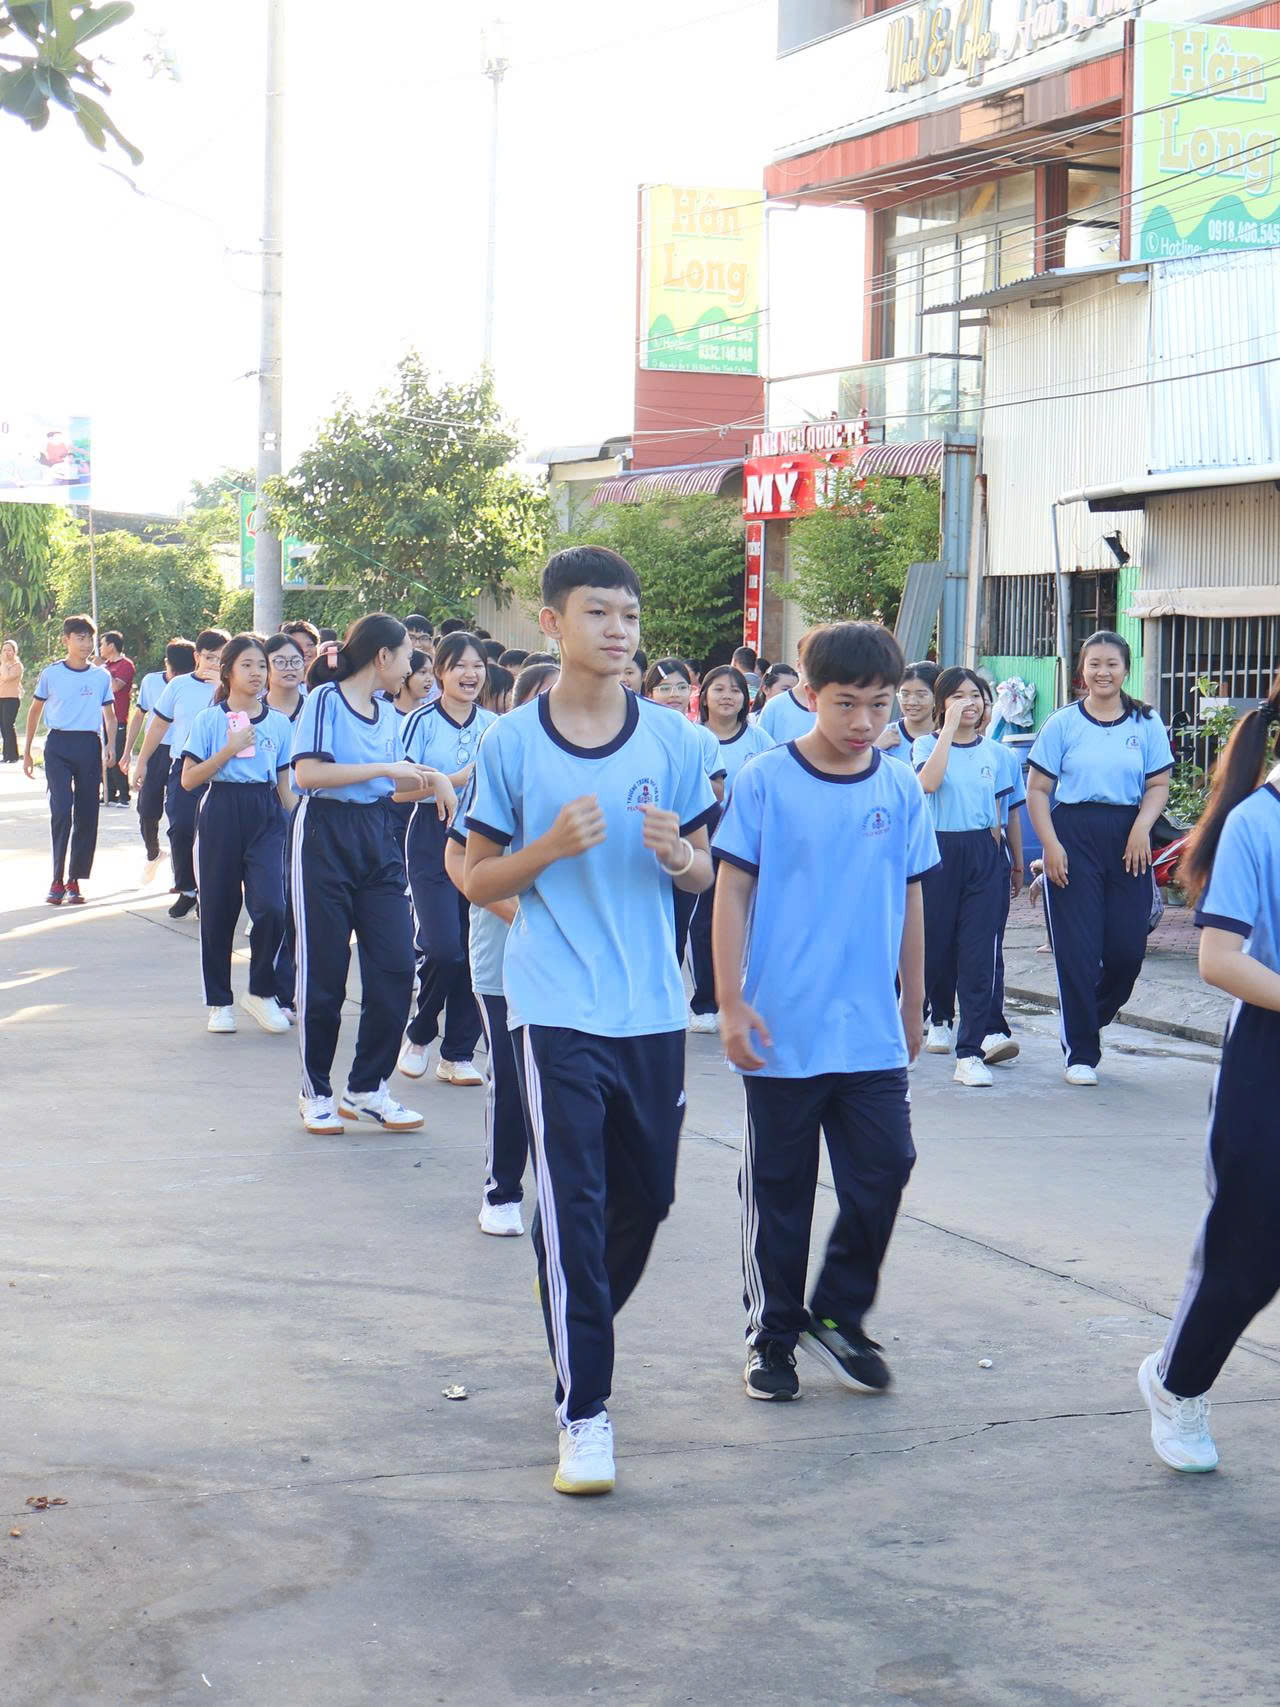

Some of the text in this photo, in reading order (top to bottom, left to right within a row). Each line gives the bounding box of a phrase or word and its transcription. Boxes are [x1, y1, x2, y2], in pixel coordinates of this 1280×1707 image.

[1170, 30, 1266, 102] Hân
[1159, 106, 1275, 196] Long
[671, 190, 743, 239] Hân
[663, 242, 749, 306] Long
[746, 462, 798, 513] MỸ
